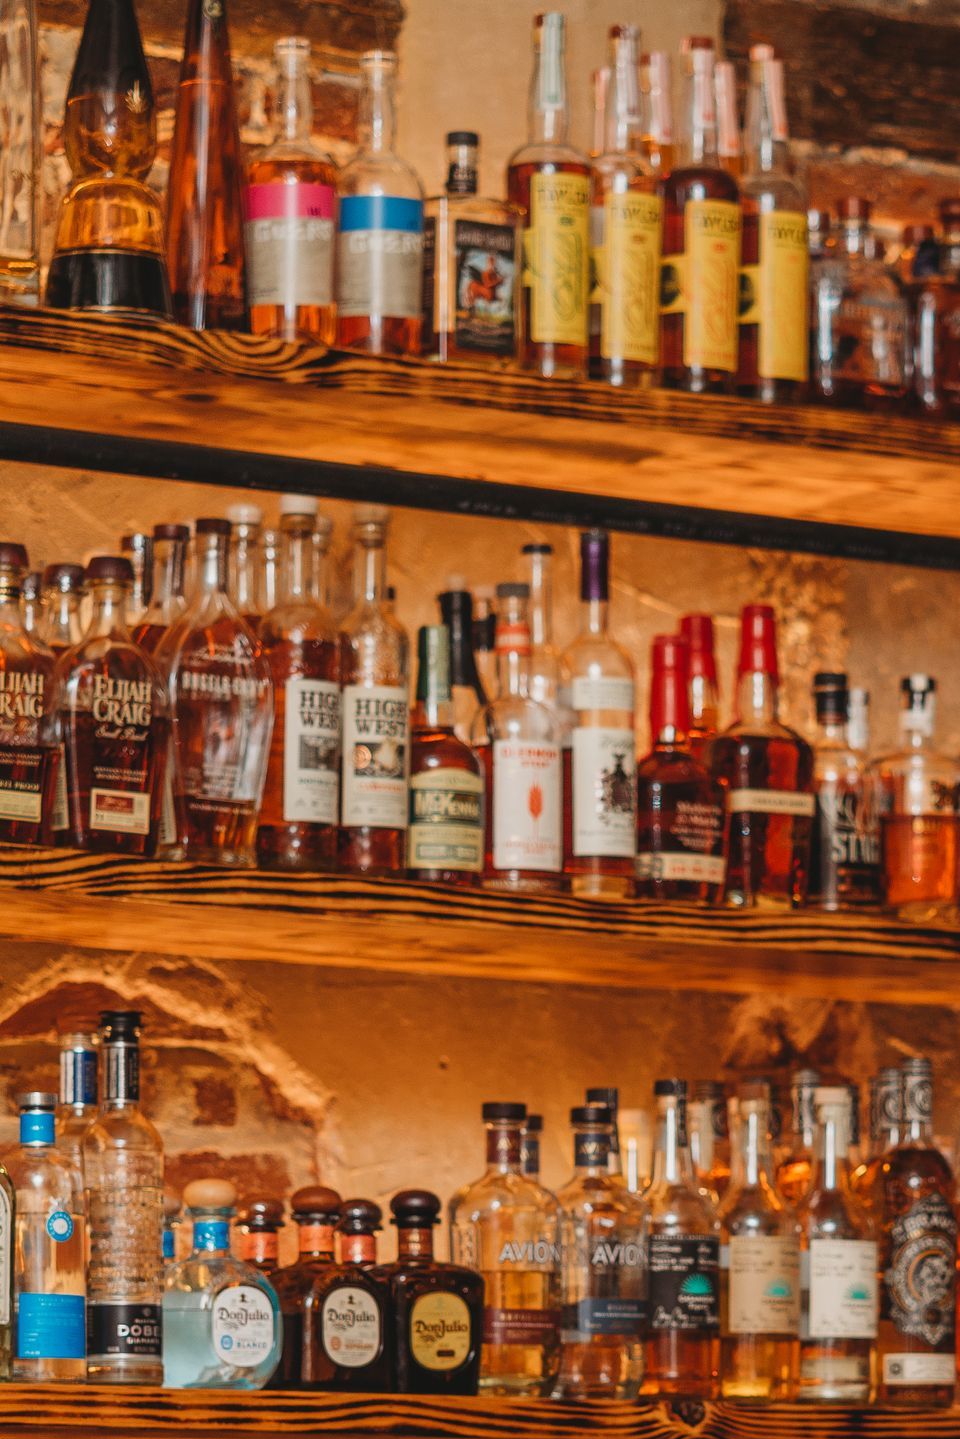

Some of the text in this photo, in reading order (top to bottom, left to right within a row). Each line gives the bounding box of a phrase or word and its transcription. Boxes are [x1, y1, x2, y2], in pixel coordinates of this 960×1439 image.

[0, 671, 44, 696] LIJAH
[94, 674, 152, 704] ELIJAH
[0, 695, 44, 719] RAIG
[93, 699, 151, 726] CRAIG
[217, 1307, 270, 1325] Don Julio
[327, 1308, 375, 1327] Don Julio
[415, 1320, 468, 1337] Don Julio
